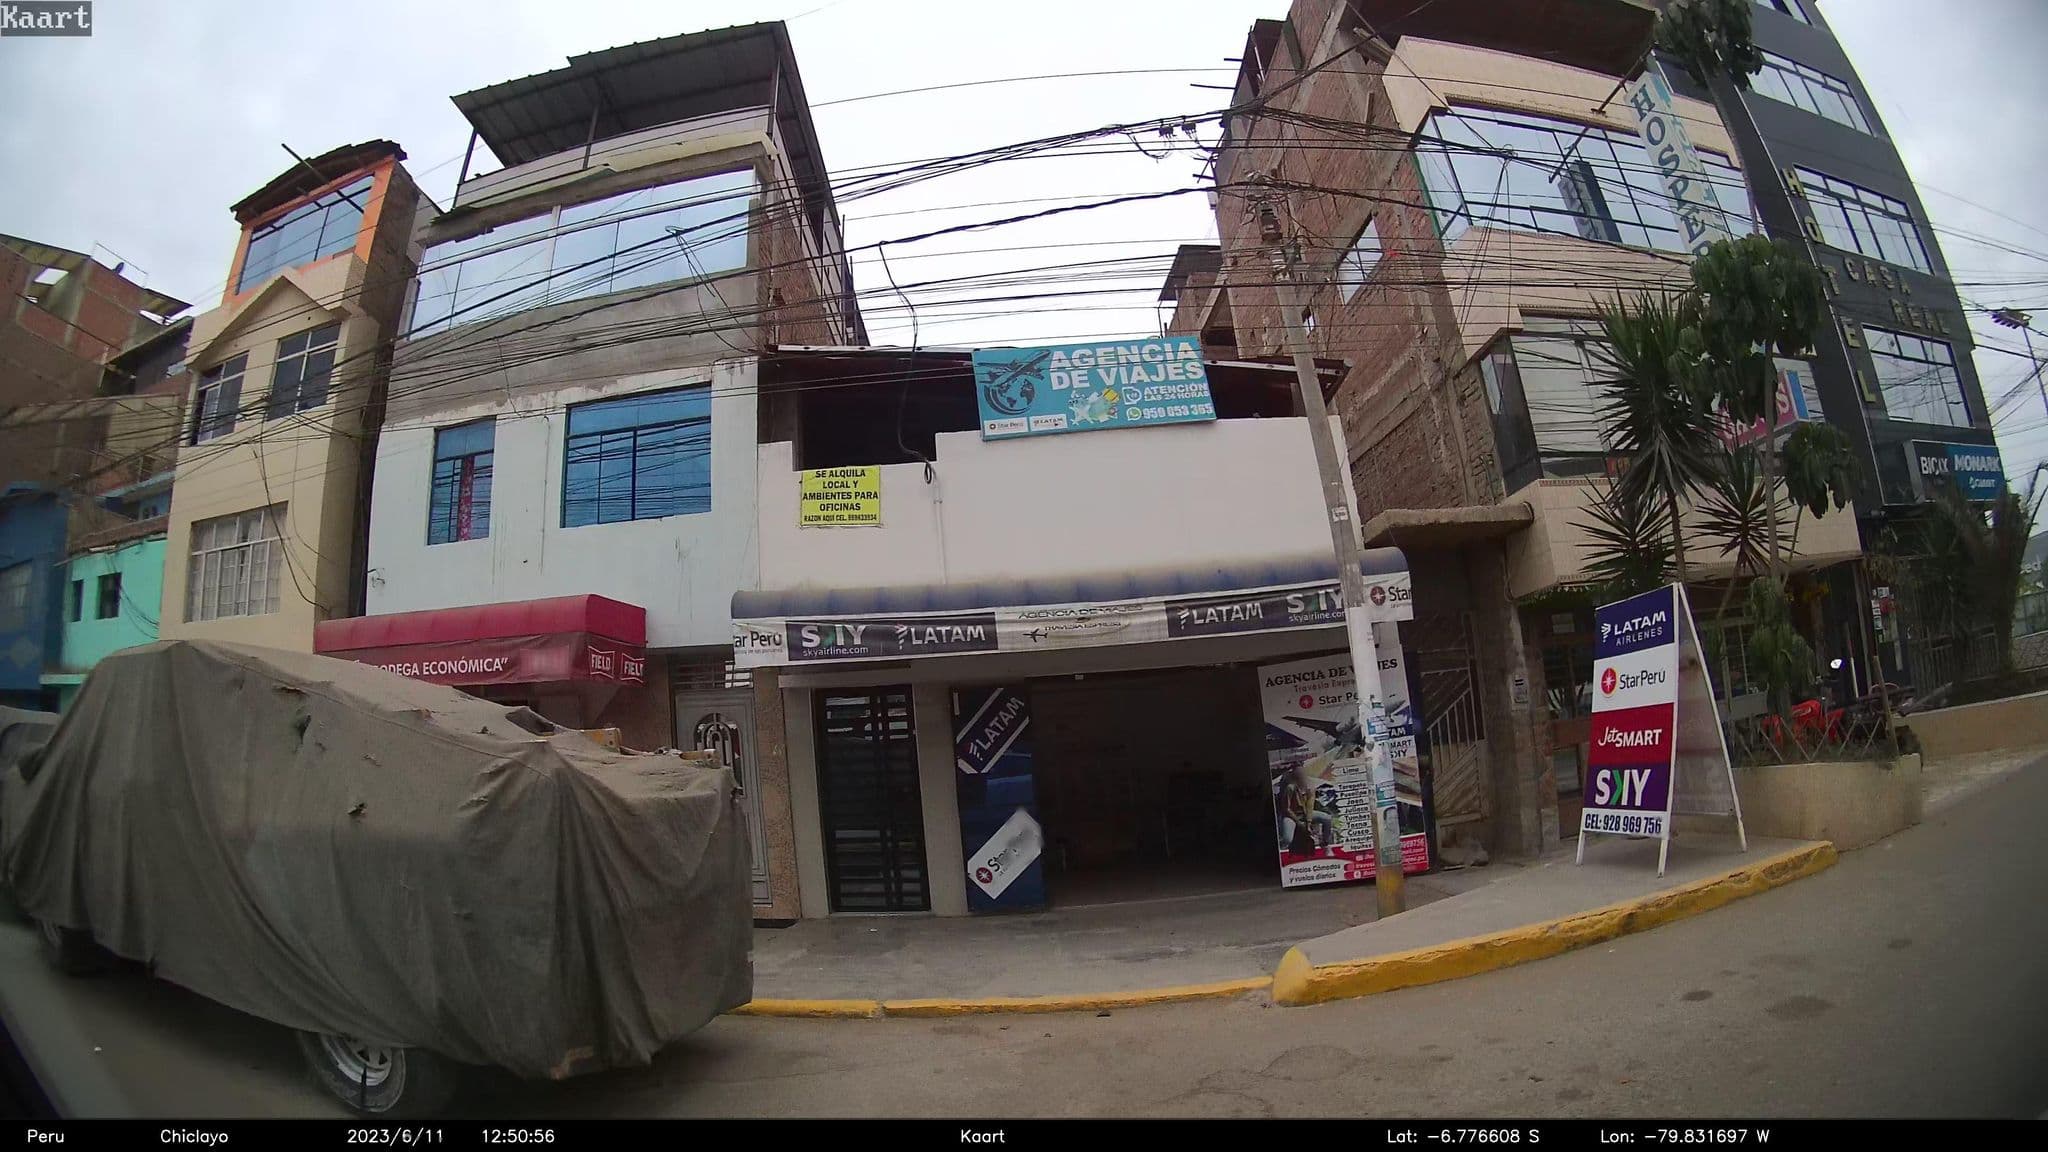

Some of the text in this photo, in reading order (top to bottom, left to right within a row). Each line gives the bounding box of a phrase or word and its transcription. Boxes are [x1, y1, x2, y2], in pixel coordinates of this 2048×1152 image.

[1782, 168, 1876, 403] HOTEL
[1050, 342, 1200, 369] AGENCIA
[1051, 361, 1205, 390] DE VIAJES
[1954, 454, 2000, 472] MONARK
[815, 469, 866, 479] SE ALQUILA
[822, 480, 858, 489] LOCAL Y
[803, 491, 878, 501] AMBIENTES PARA
[819, 502, 861, 512] OFICINAS
[1192, 602, 1264, 625] LATAM
[1614, 610, 1667, 636] LATAM
[910, 624, 986, 645] LATAM
[1616, 626, 1663, 646] AIRLENES
[802, 646, 869, 657] skyairline.com
[591, 654, 611, 671] FIELD
[1265, 670, 1326, 688] AGENCIA
[1329, 666, 1348, 678] DE
[1318, 695, 1342, 705] Star
[976, 697, 1025, 751] LATAM
[1584, 813, 1662, 834] CEL: 928 969 756
